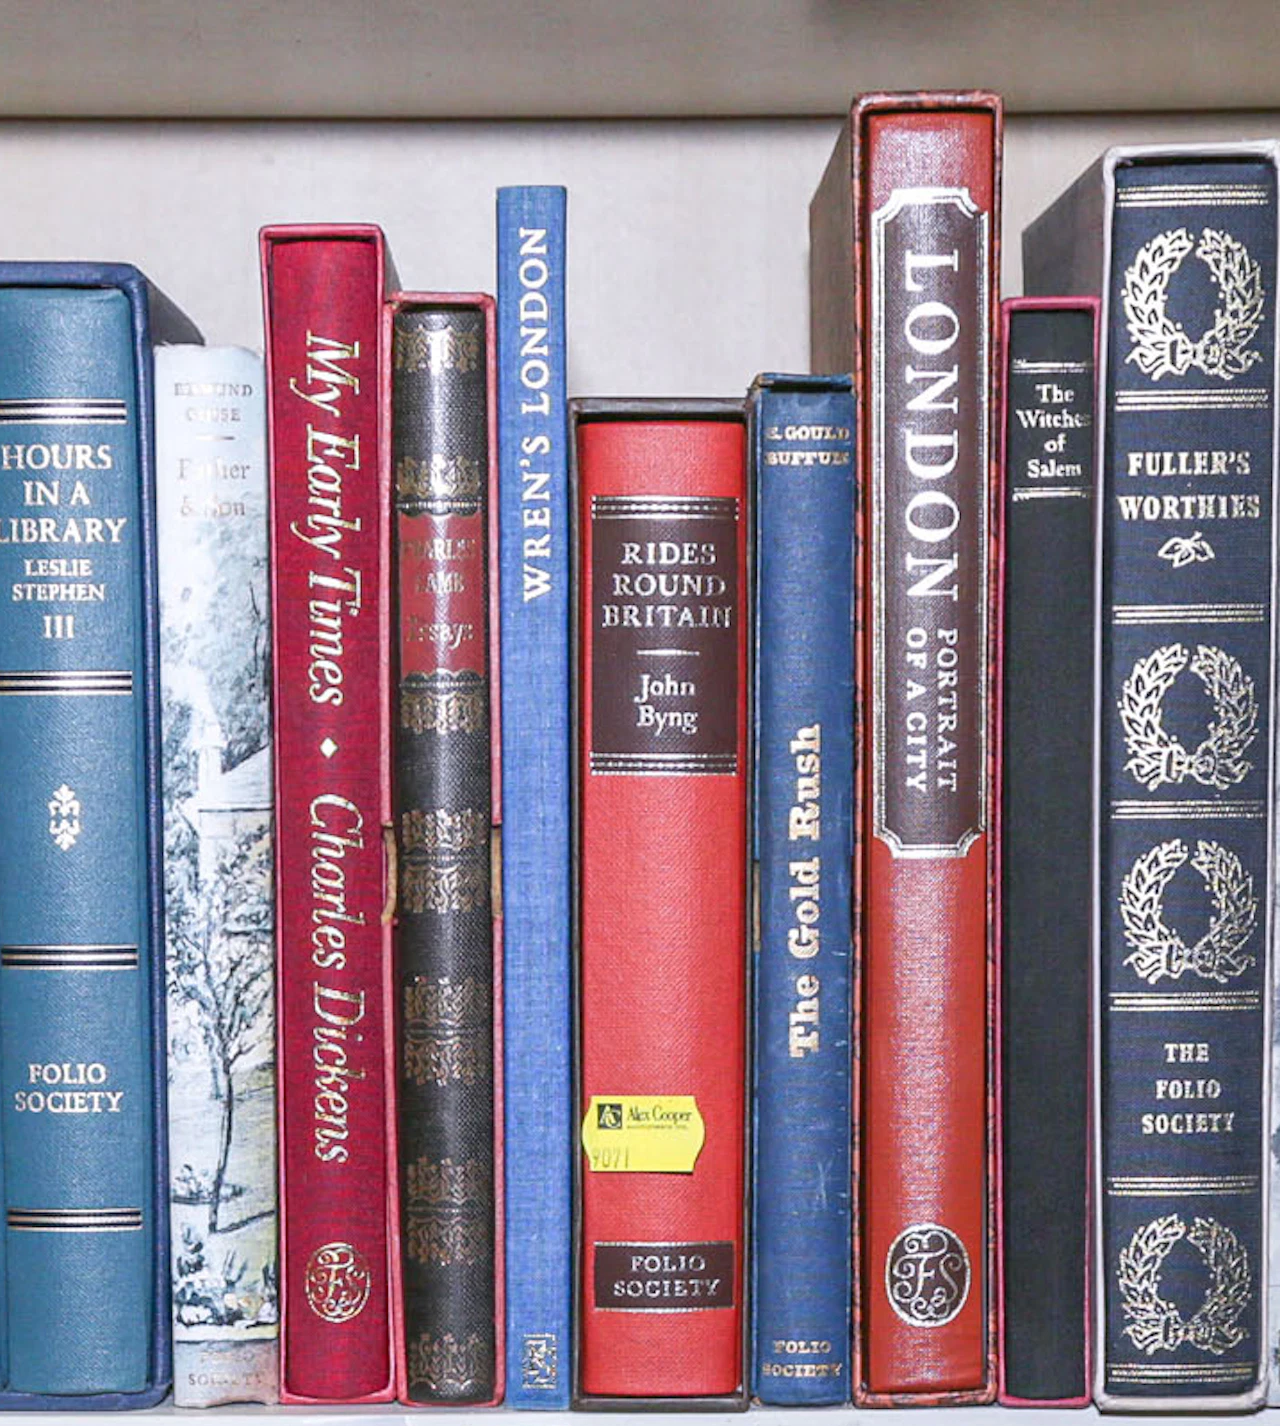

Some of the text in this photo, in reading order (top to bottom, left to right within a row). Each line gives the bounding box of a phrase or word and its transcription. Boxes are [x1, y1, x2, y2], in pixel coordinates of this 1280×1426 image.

[1036, 385, 1074, 402] The
[519, 227, 554, 604] WREN'S LONDON
[904, 249, 961, 602] LONDON
[1045, 435, 1066, 452] of
[1028, 458, 1081, 478] Salem
[1128, 451, 1251, 477] FULLER'S
[1120, 495, 1260, 520] WORTHIES
[620, 542, 716, 564] RIDES
[612, 573, 726, 596] ROUND
[602, 606, 731, 628] BRITAIN
[635, 675, 695, 702] John
[638, 707, 698, 735] Byng
[905, 627, 928, 793] OF A CITY
[937, 627, 959, 793] PORTRAIT
[289, 329, 366, 1166] My Early Times Charles Dickens
[788, 723, 821, 1058] The Gold Rush
[628, 1105, 692, 1124] Alex Cooper
[630, 1256, 705, 1272] FOLIO
[613, 1279, 721, 1297] SOCIETY
